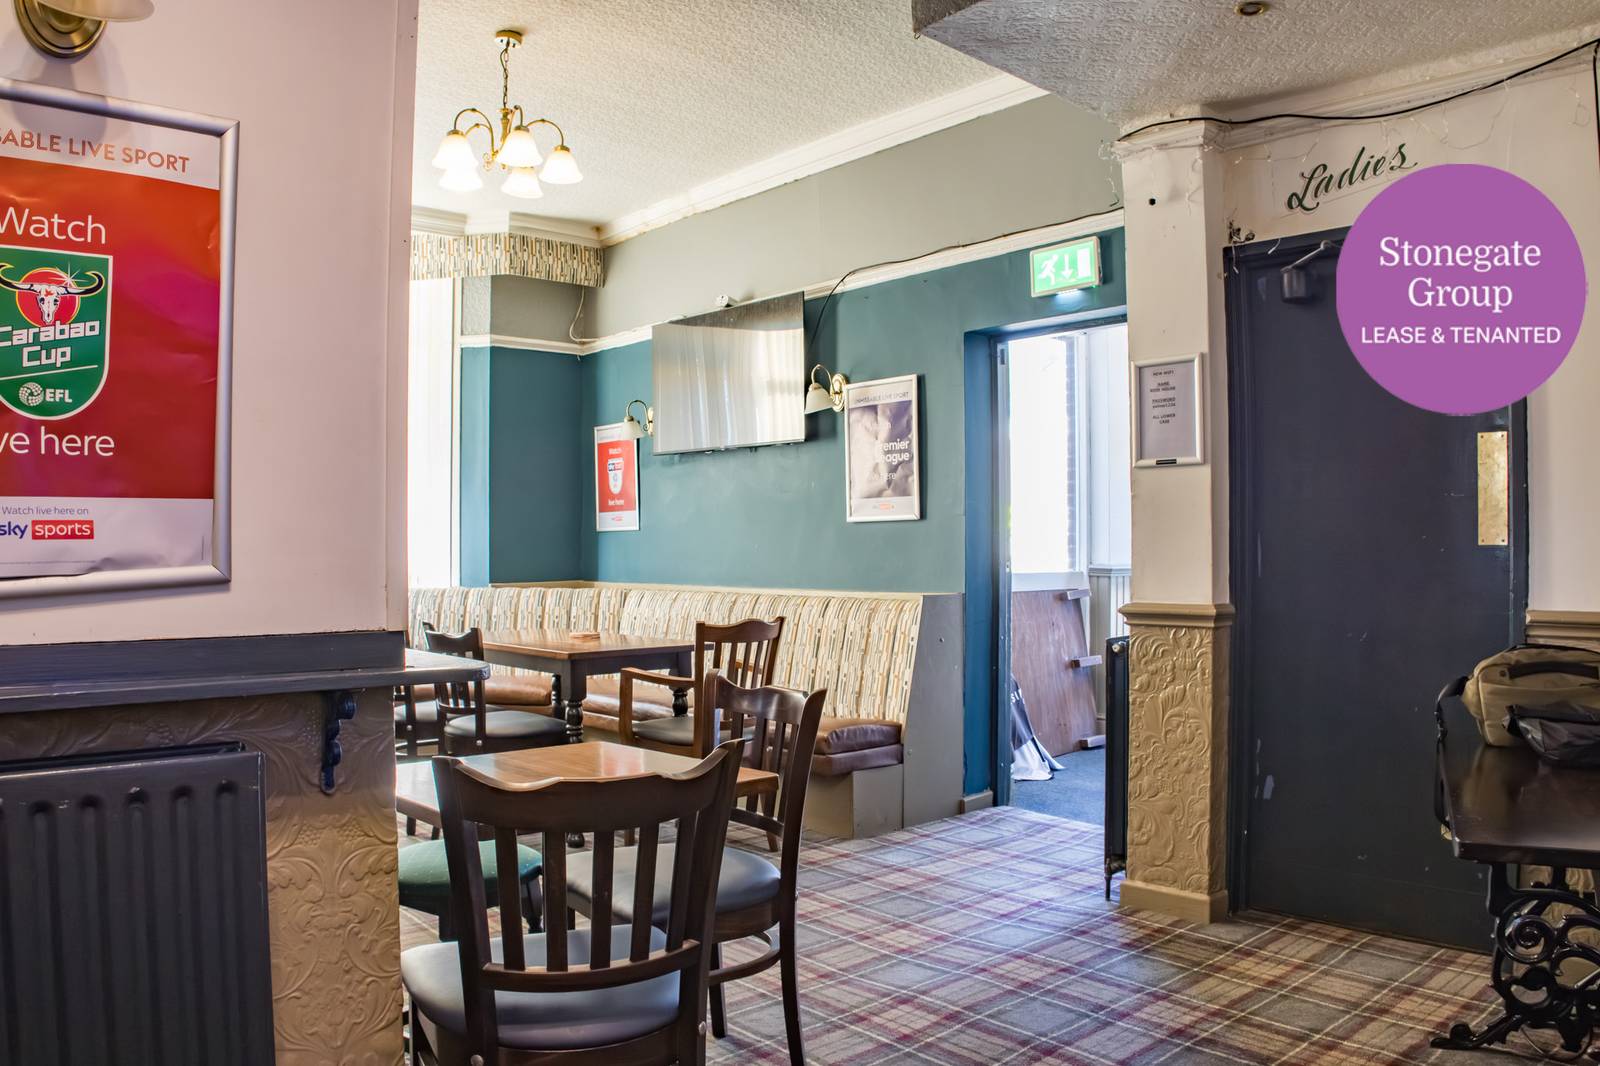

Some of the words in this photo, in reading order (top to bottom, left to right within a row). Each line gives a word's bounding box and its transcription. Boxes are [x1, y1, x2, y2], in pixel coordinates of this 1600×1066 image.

[0, 128, 61, 152] ABLE
[68, 137, 115, 161] LIVE
[121, 147, 190, 173] SPORT
[1286, 143, 1418, 212] Ladies
[22, 345, 71, 368] Cup
[45, 388, 73, 403] EFL
[40, 425, 115, 457] here
[2, 505, 34, 516] Watch
[36, 506, 52, 516] live
[54, 506, 76, 516] here
[78, 507, 89, 516] on
[0, 520, 28, 539] sky
[34, 522, 92, 539] sports
